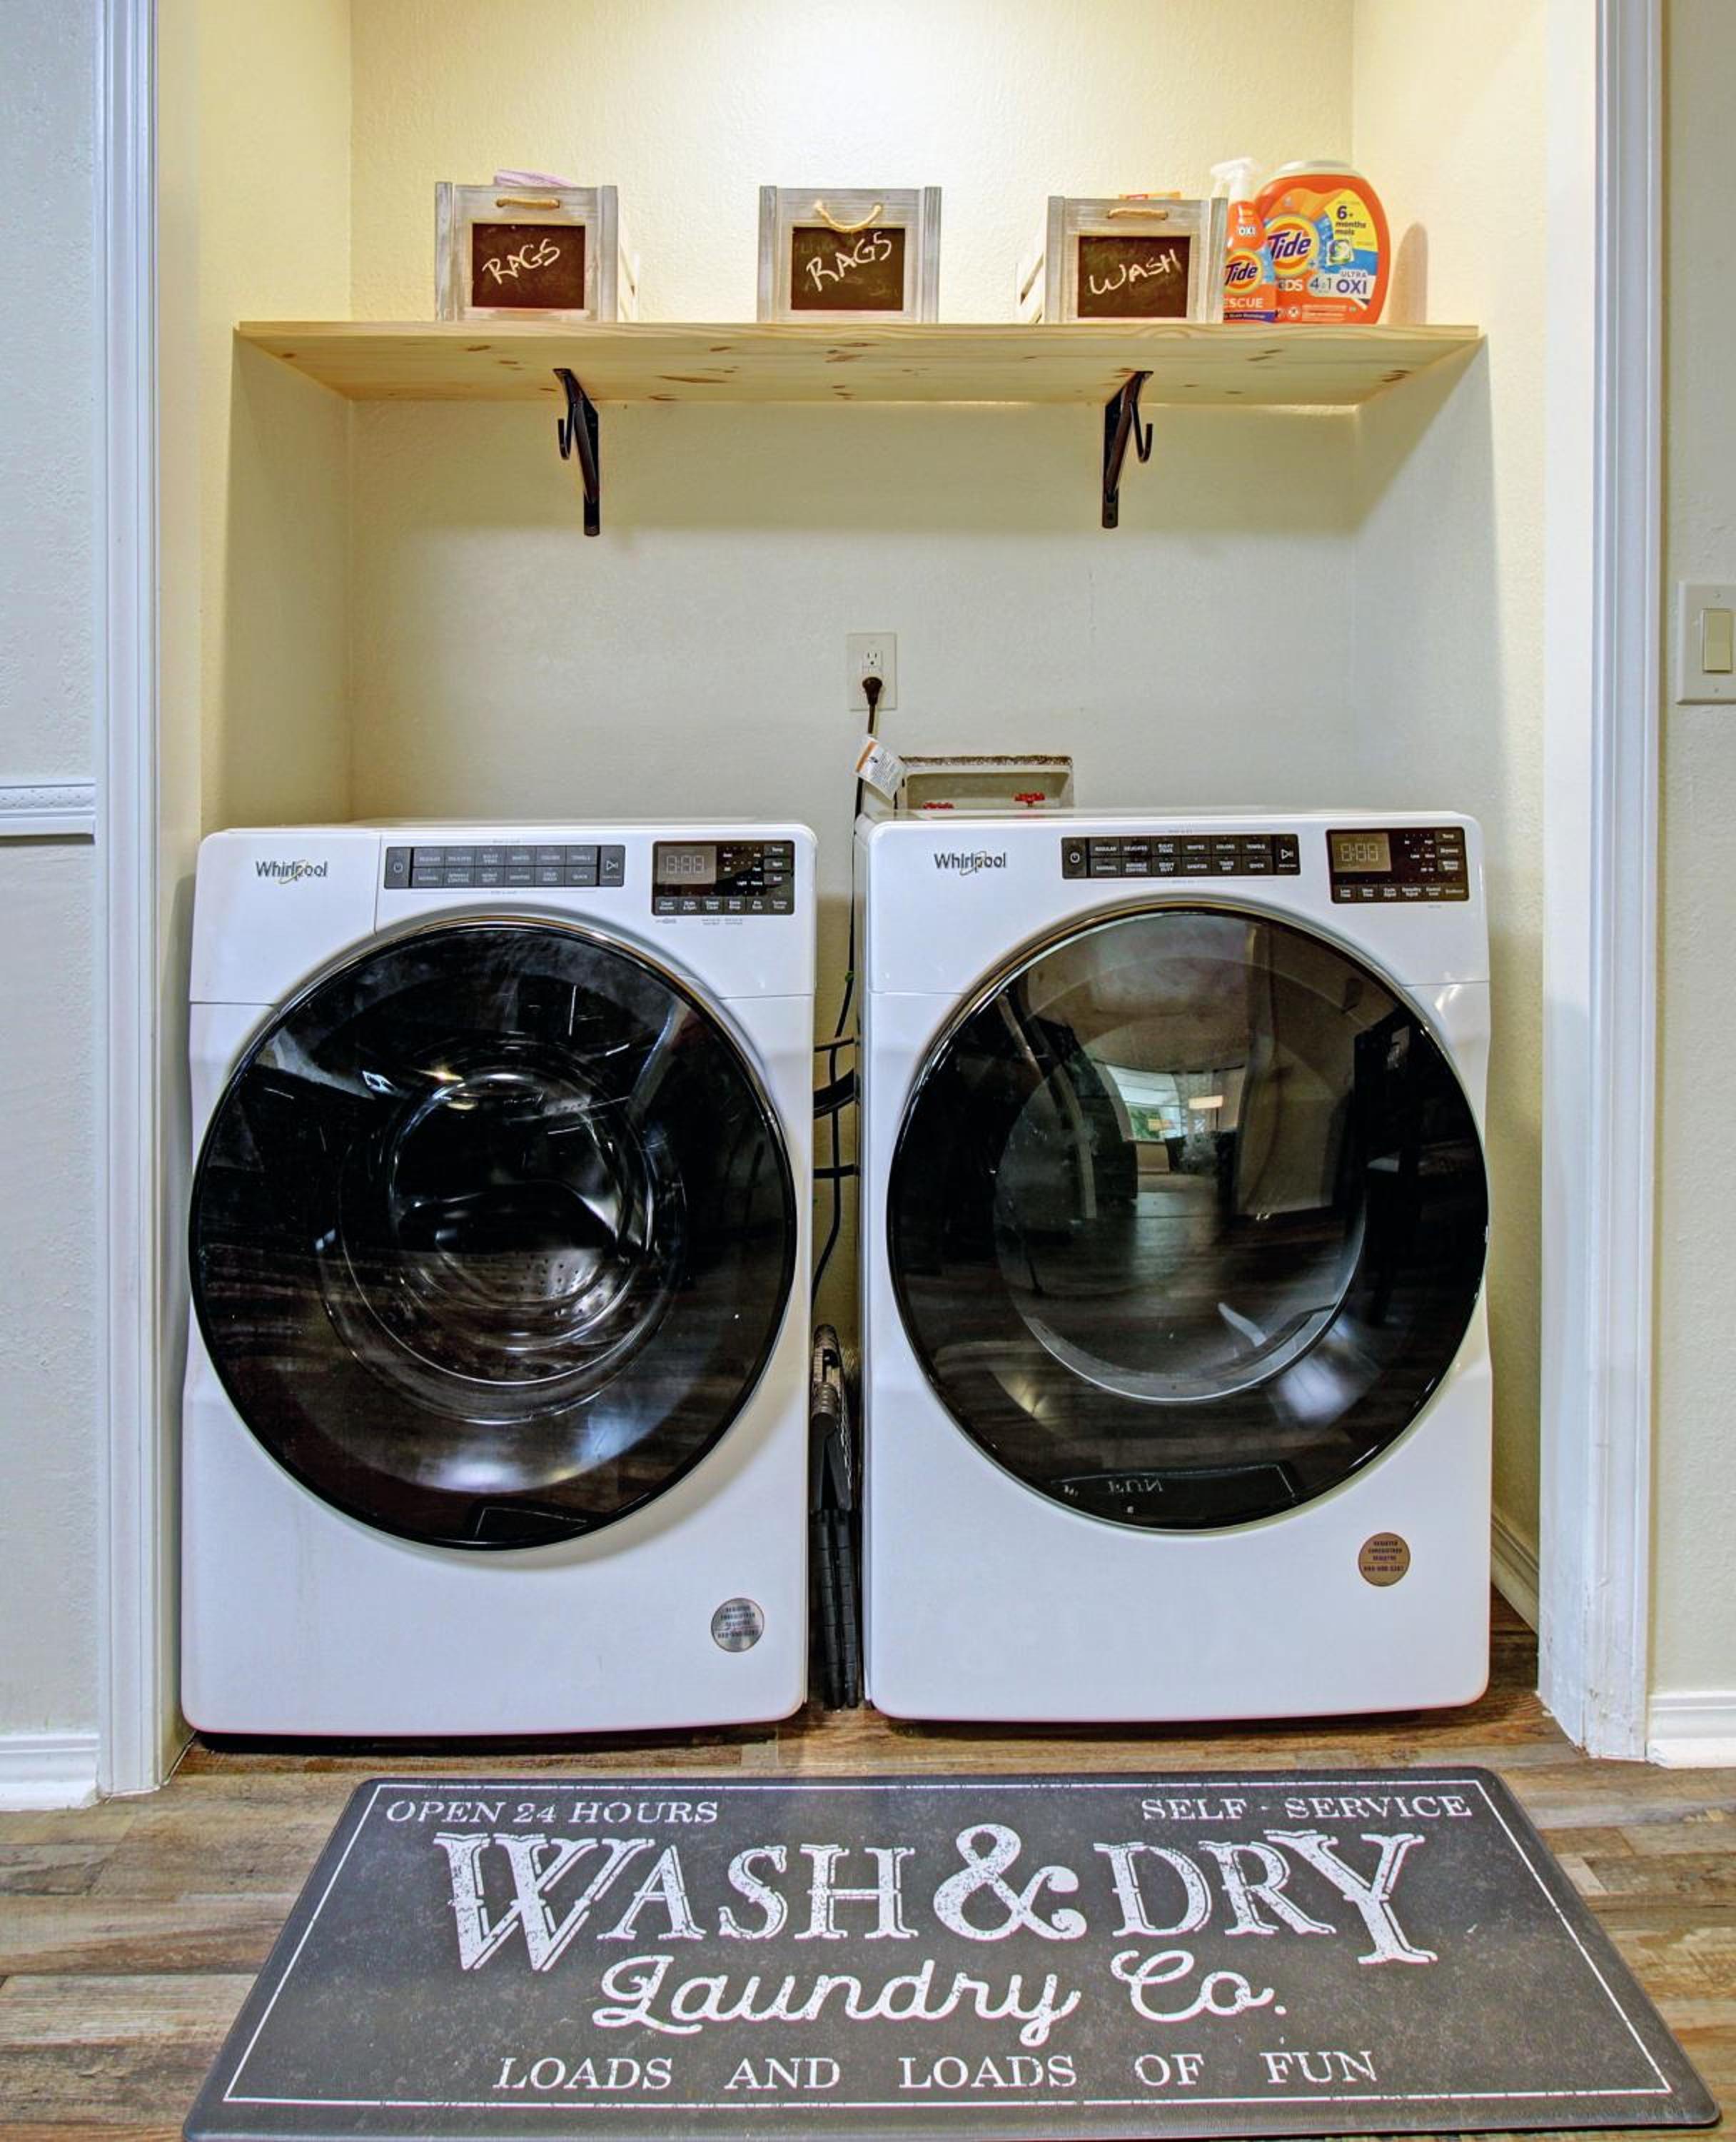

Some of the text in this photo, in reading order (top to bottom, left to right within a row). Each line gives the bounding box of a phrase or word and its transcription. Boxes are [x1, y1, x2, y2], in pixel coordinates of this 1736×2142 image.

[1268, 231, 1311, 260] Tide
[483, 238, 561, 285] RAGS
[806, 231, 893, 292] RAGS
[1089, 248, 1182, 296] WASH
[1225, 261, 1258, 286] Tide
[1336, 279, 1367, 294] OXI
[256, 860, 328, 884] Whirlpool
[934, 850, 1006, 875] Whirlpool
[386, 1800, 719, 1824] OPEN 24 HOURS
[1141, 1798, 1248, 1821] SELF
[1286, 1794, 1474, 1820] SERVICE
[433, 1823, 1438, 1972] WASH & DRY
[591, 1949, 1287, 2048] Laundry Co.
[492, 2050, 1378, 2091] LOADS AND LOADS OF FUN
